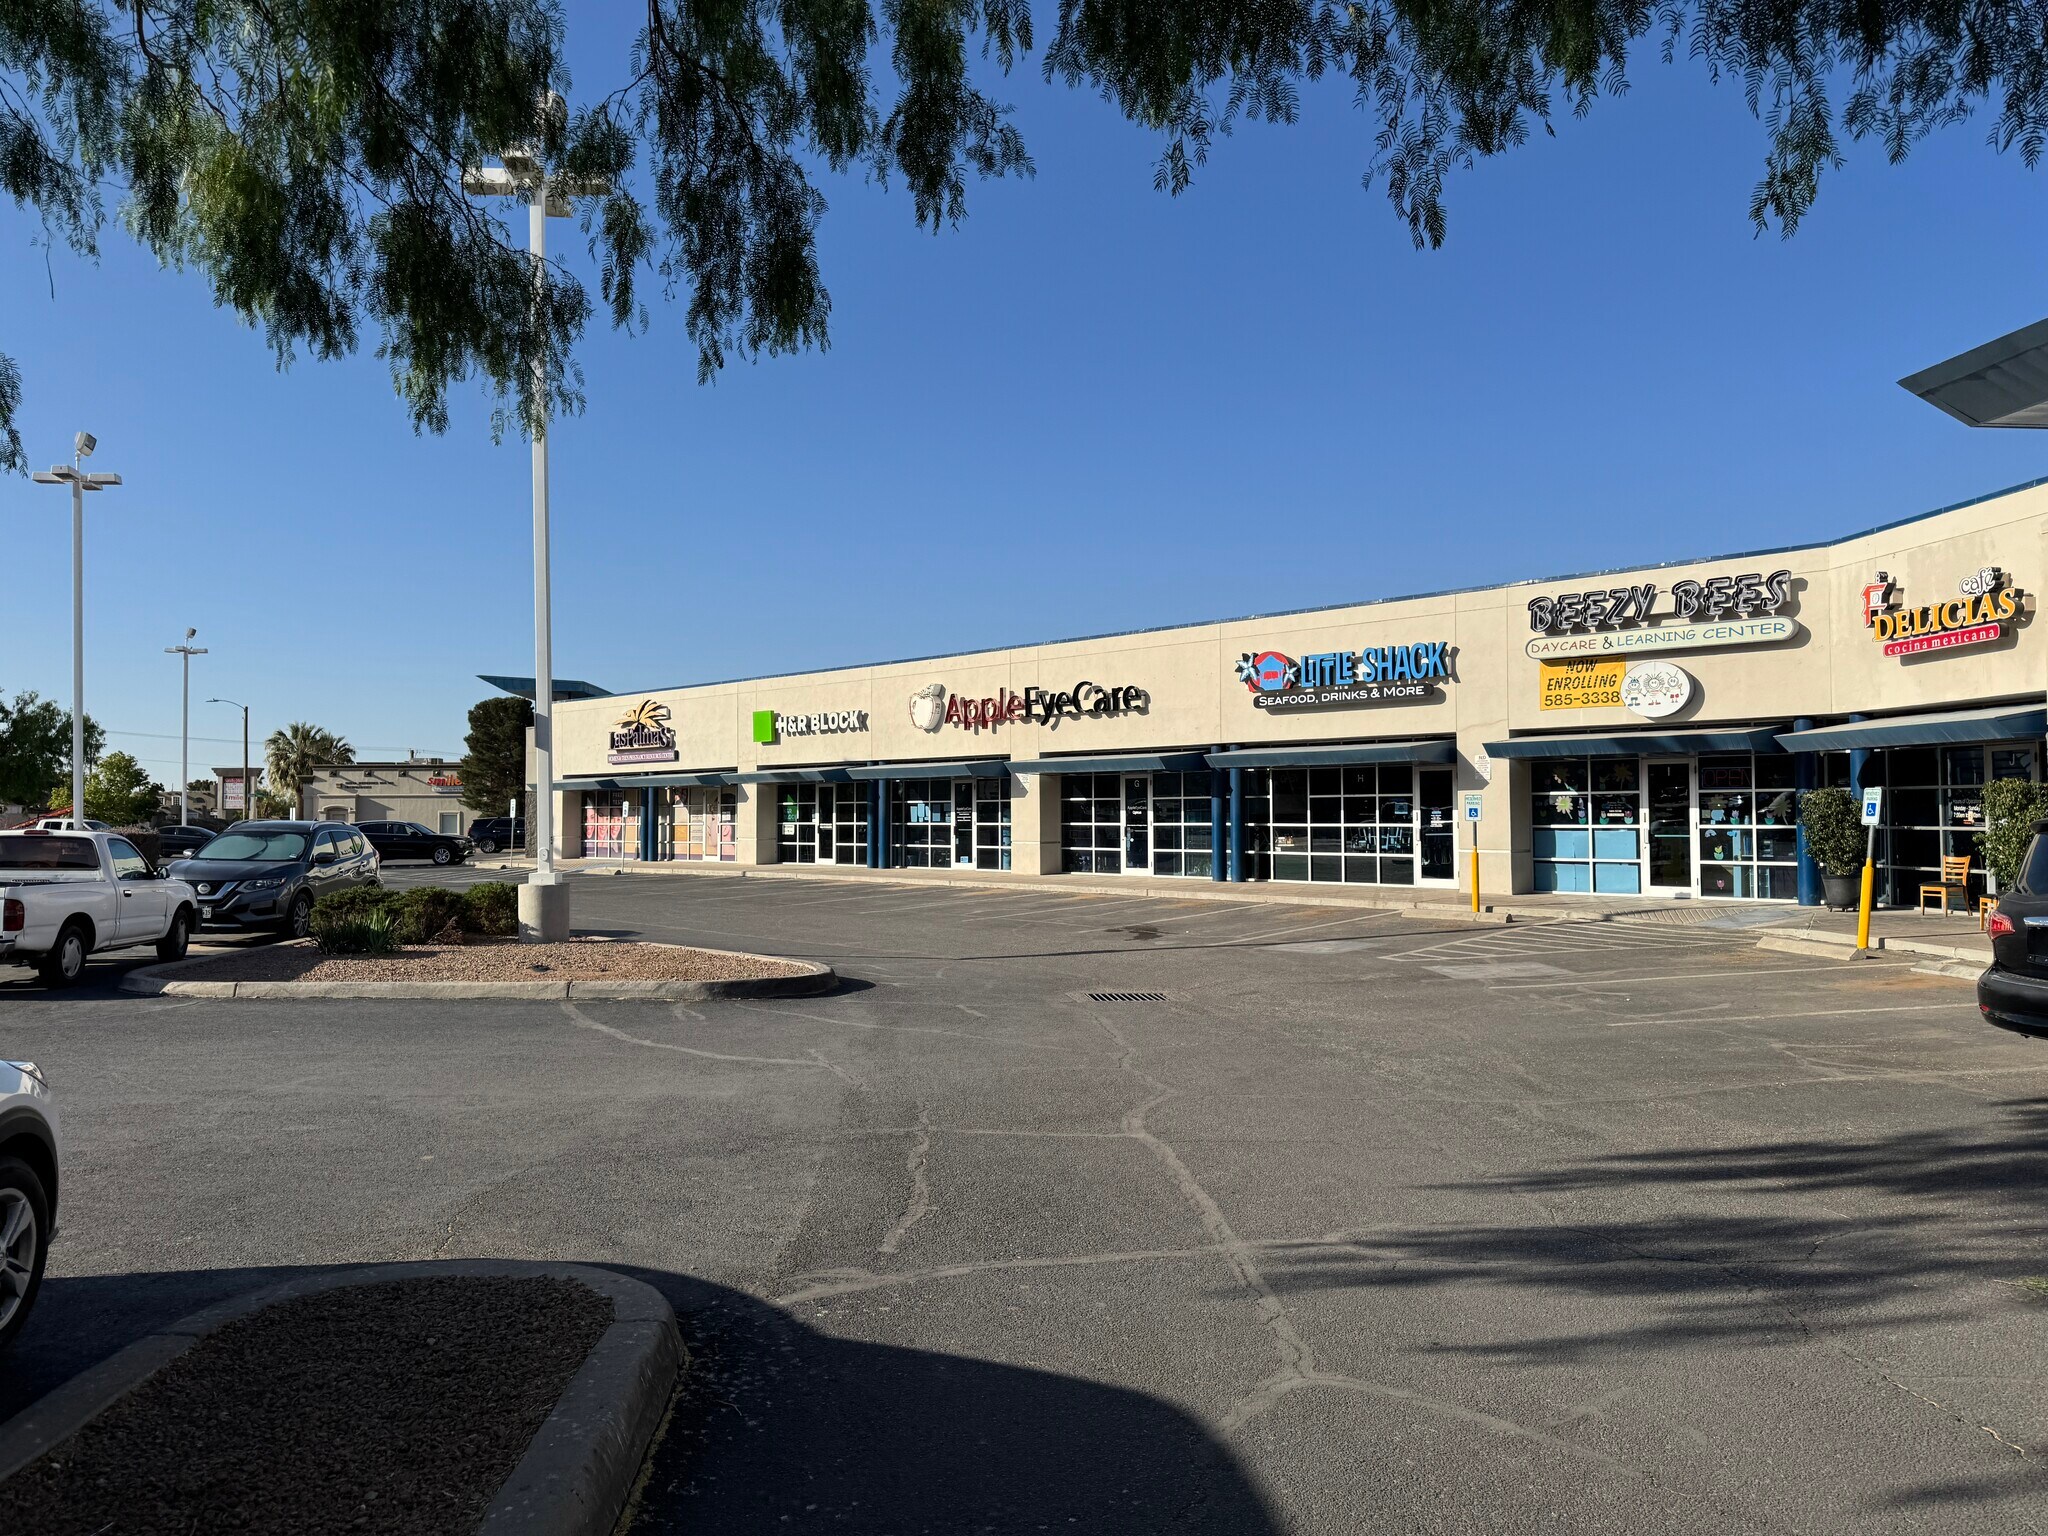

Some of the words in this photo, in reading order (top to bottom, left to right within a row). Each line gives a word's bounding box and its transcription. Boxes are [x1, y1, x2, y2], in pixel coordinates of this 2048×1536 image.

[1960, 568, 1995, 595] café
[1528, 584, 1656, 633] BEEZY
[1672, 570, 1792, 618] BEES
[1872, 588, 2016, 642] DELICIAS
[1531, 639, 1597, 654] DAYCARE
[1602, 636, 1614, 650] &
[1617, 629, 1696, 647] LEARNING
[1703, 622, 1787, 640] CENTER
[1887, 640, 1928, 655] cocina
[1931, 628, 1995, 648] mexicana
[1301, 651, 1355, 688] LITTLE
[1362, 641, 1448, 683] SHACK
[1566, 659, 1598, 674] NOW
[1321, 690, 1368, 702] DRINKS
[1370, 688, 1381, 698] &
[1383, 685, 1424, 697] MORE
[1547, 674, 1618, 691] ENROLLING
[1544, 690, 1620, 706] 585-3338
[776, 714, 807, 733] H&R
[810, 710, 860, 731] BLOCK
[1703, 768, 1752, 787] OPEN
